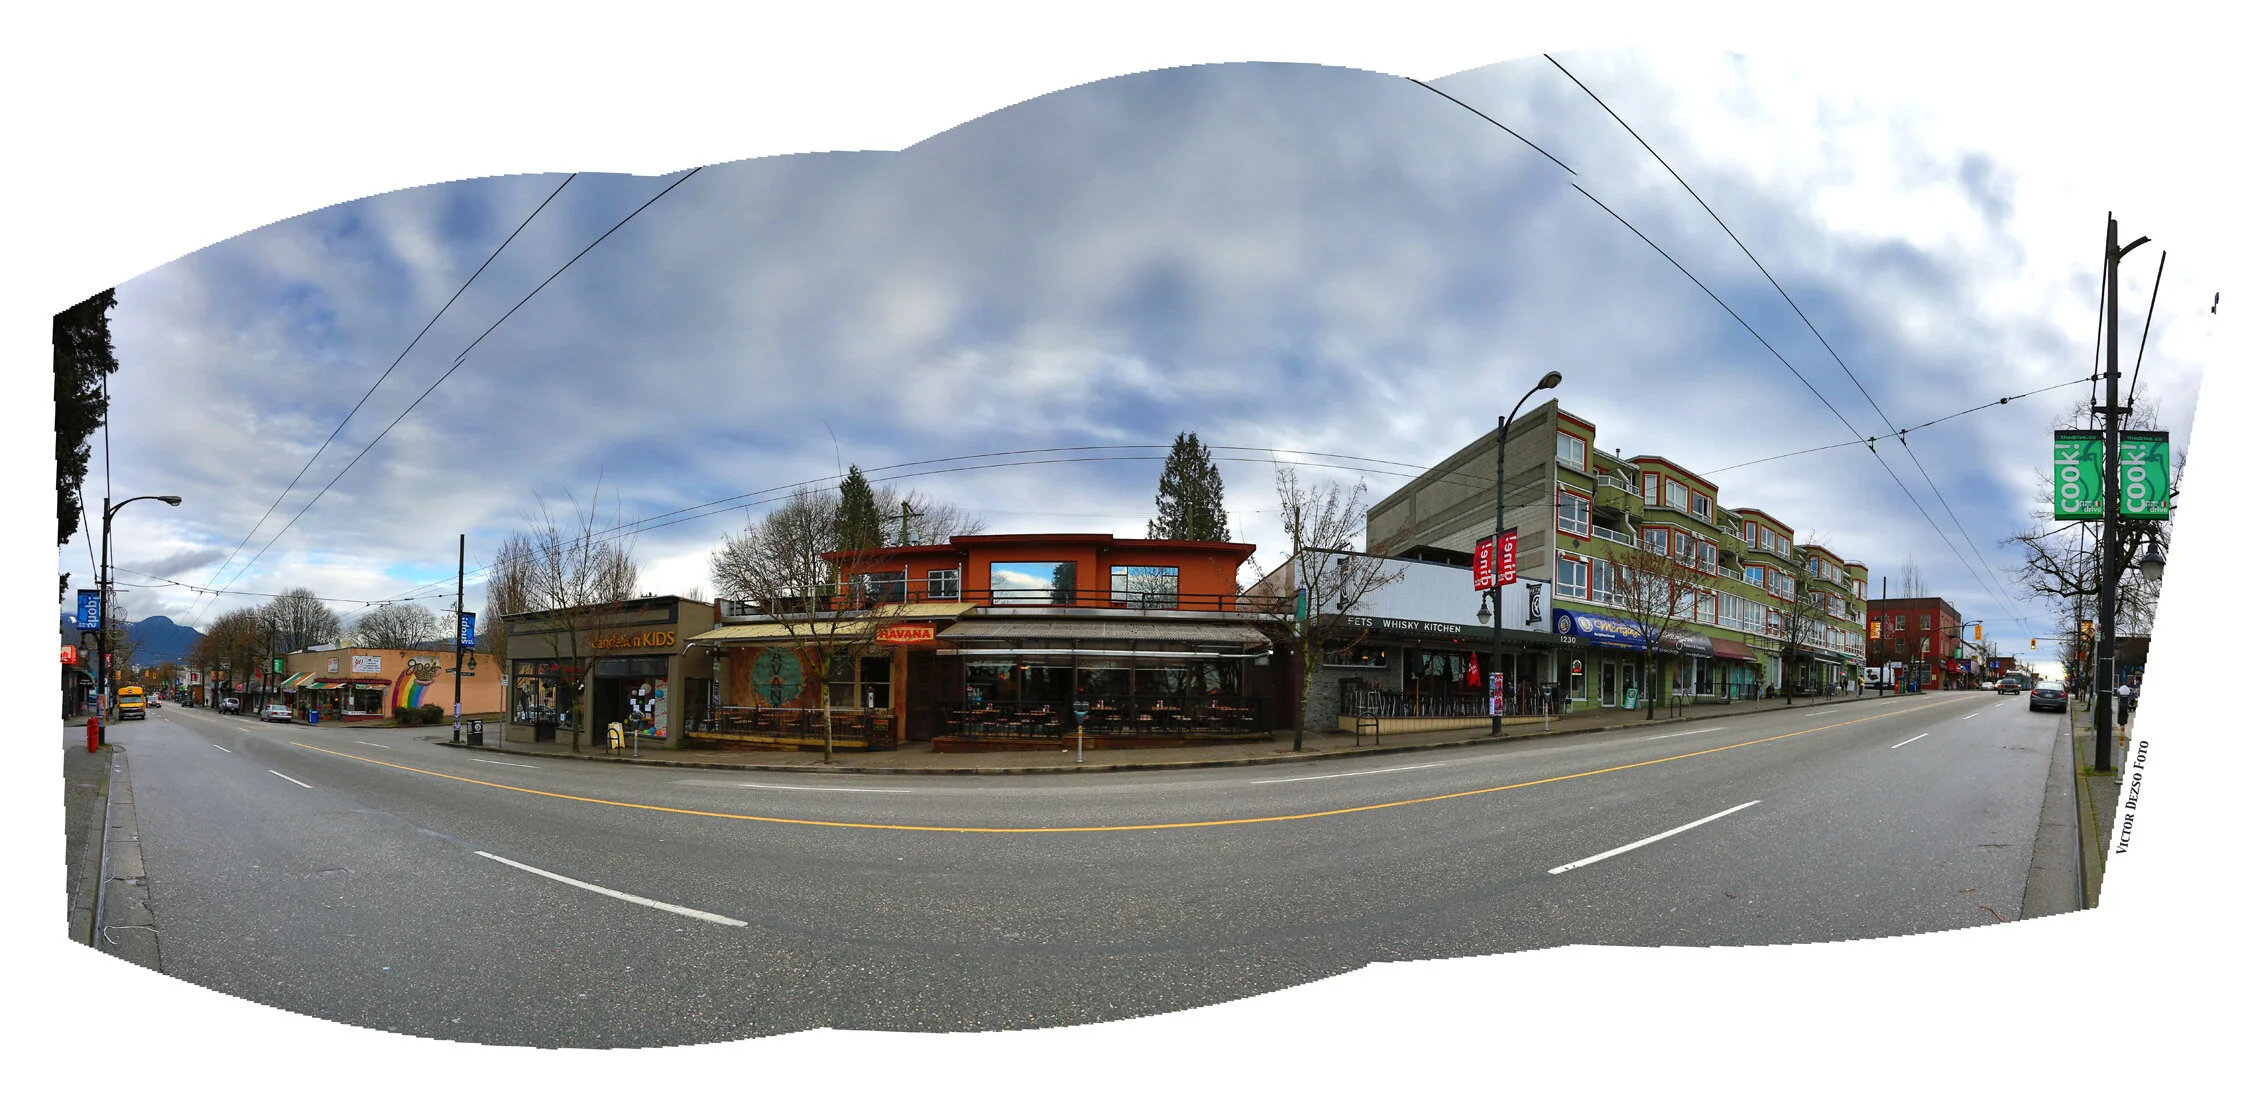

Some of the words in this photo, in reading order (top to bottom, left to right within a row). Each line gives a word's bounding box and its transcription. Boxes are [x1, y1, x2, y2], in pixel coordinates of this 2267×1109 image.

[2054, 443, 2080, 513] cook!
[2121, 444, 2146, 513] cook!
[2084, 504, 2101, 513] drive
[2149, 504, 2168, 513] drive
[1348, 616, 1373, 628] FETS
[1382, 619, 1420, 630] WHISKY
[1424, 623, 1461, 633] KITCHEN
[643, 630, 675, 647] KIDS
[880, 629, 931, 639] HAVANA
[1560, 635, 1576, 644] 1230
[406, 658, 441, 676] Joe's
